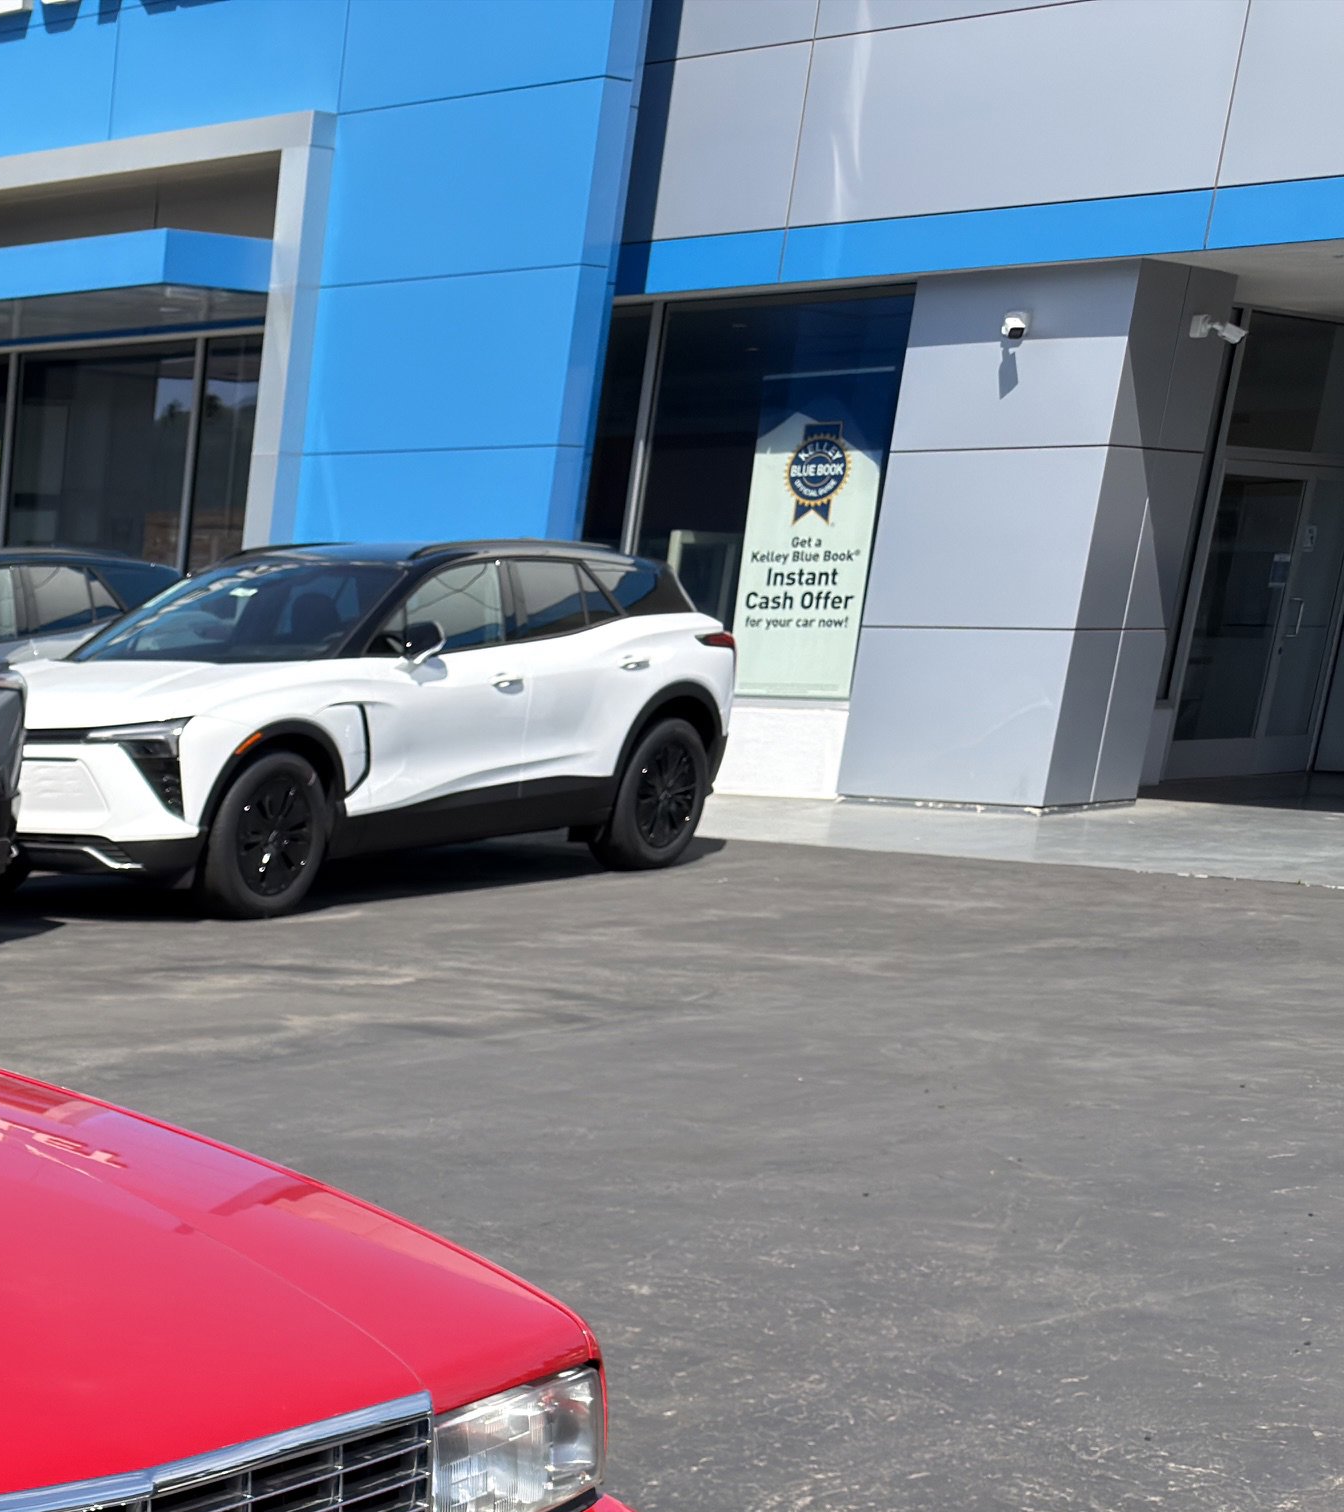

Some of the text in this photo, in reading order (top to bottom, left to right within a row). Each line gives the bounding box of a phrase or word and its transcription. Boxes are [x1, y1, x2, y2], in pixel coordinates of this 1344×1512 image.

[798, 441, 843, 461] KELLEY
[790, 462, 844, 477] BLUE BOOK
[791, 536, 822, 548] Get a
[750, 551, 789, 565] Kelley
[792, 550, 819, 562] Blue
[766, 567, 838, 586] Instant
[745, 591, 855, 610] Cash Offer
[745, 616, 849, 630] for your car now!
